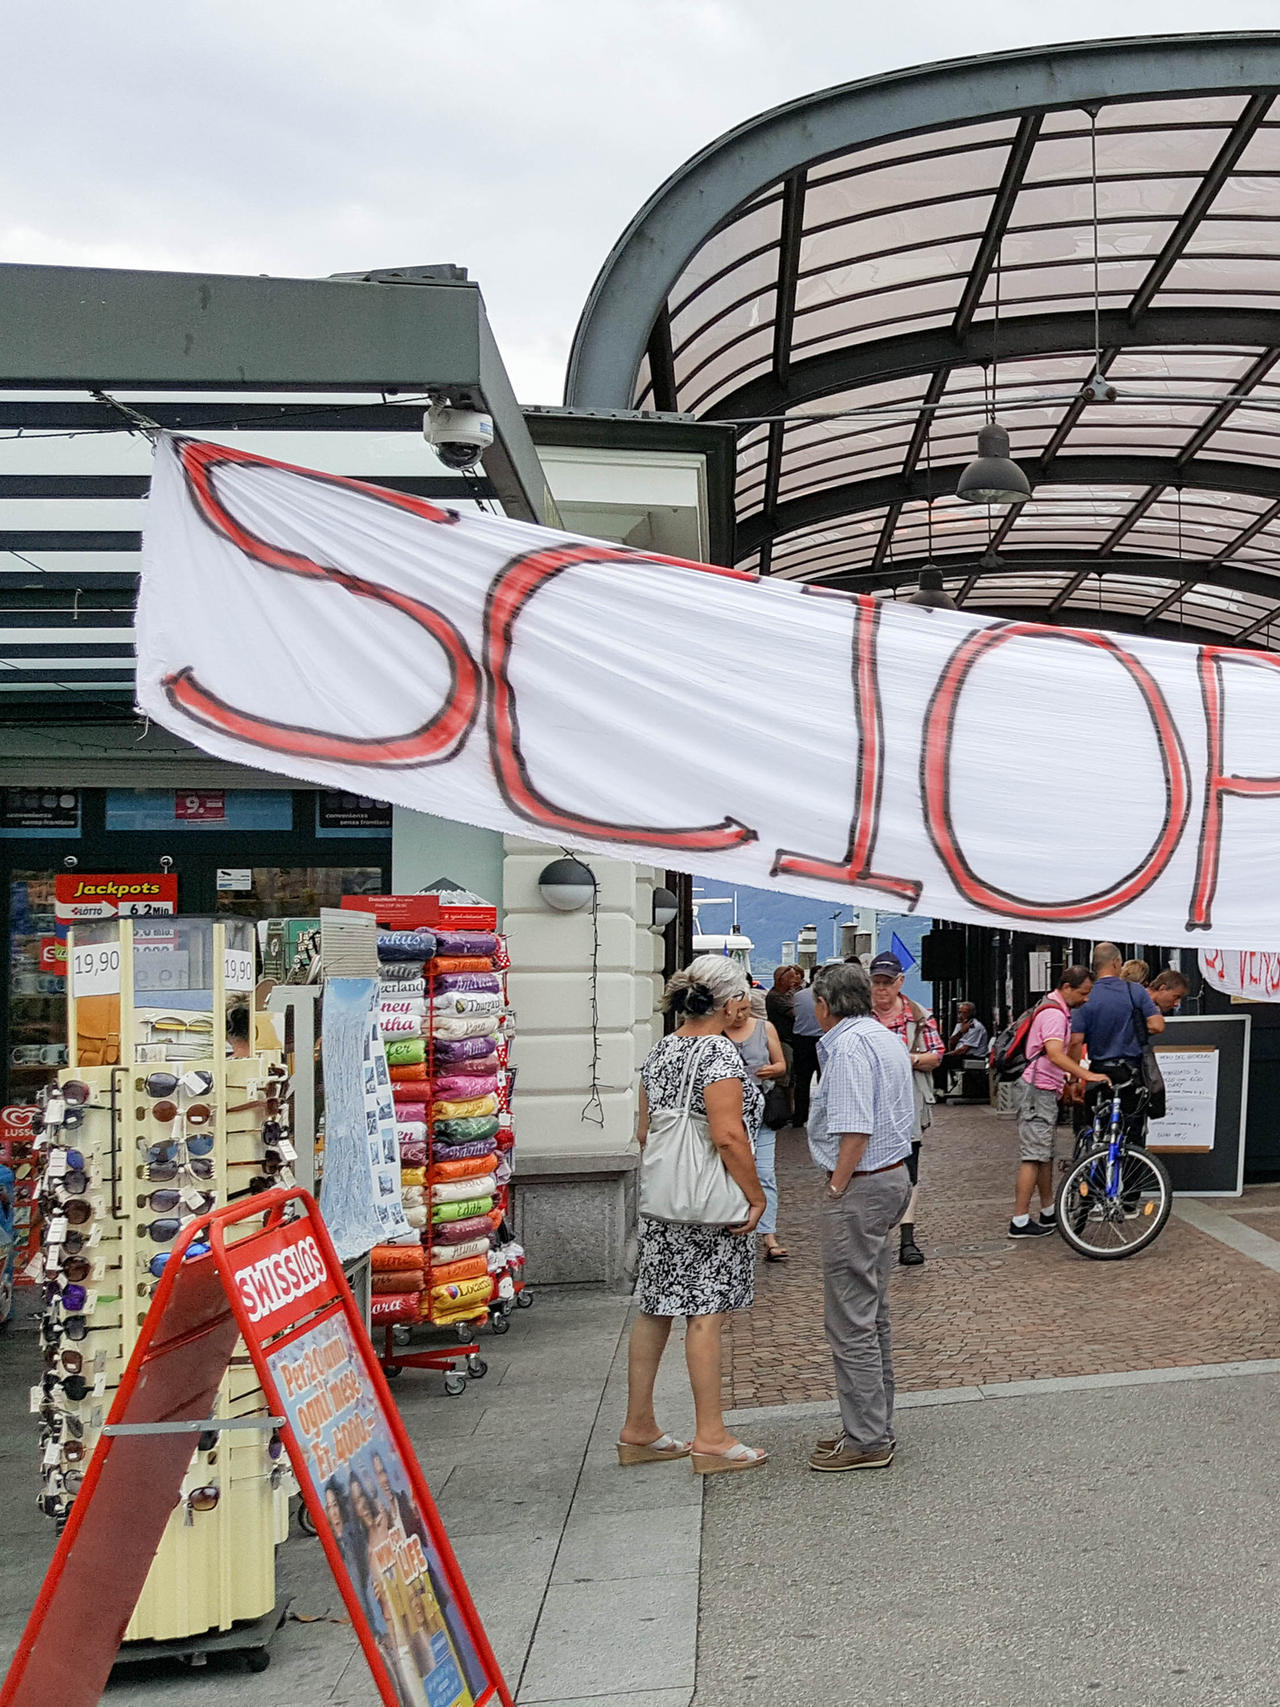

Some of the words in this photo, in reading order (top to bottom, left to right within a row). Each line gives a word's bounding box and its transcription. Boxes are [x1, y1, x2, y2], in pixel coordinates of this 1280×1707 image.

[73, 881, 161, 898] Jackpots
[78, 907, 103, 916] LOTTO
[74, 951, 120, 976] 19,90
[224, 958, 252, 981] 19,90
[380, 1016, 415, 1032] tha
[235, 1236, 327, 1322] SWISSLOS
[280, 1361, 309, 1399] Per
[297, 1379, 335, 1440] ogni
[328, 1367, 362, 1415] mese
